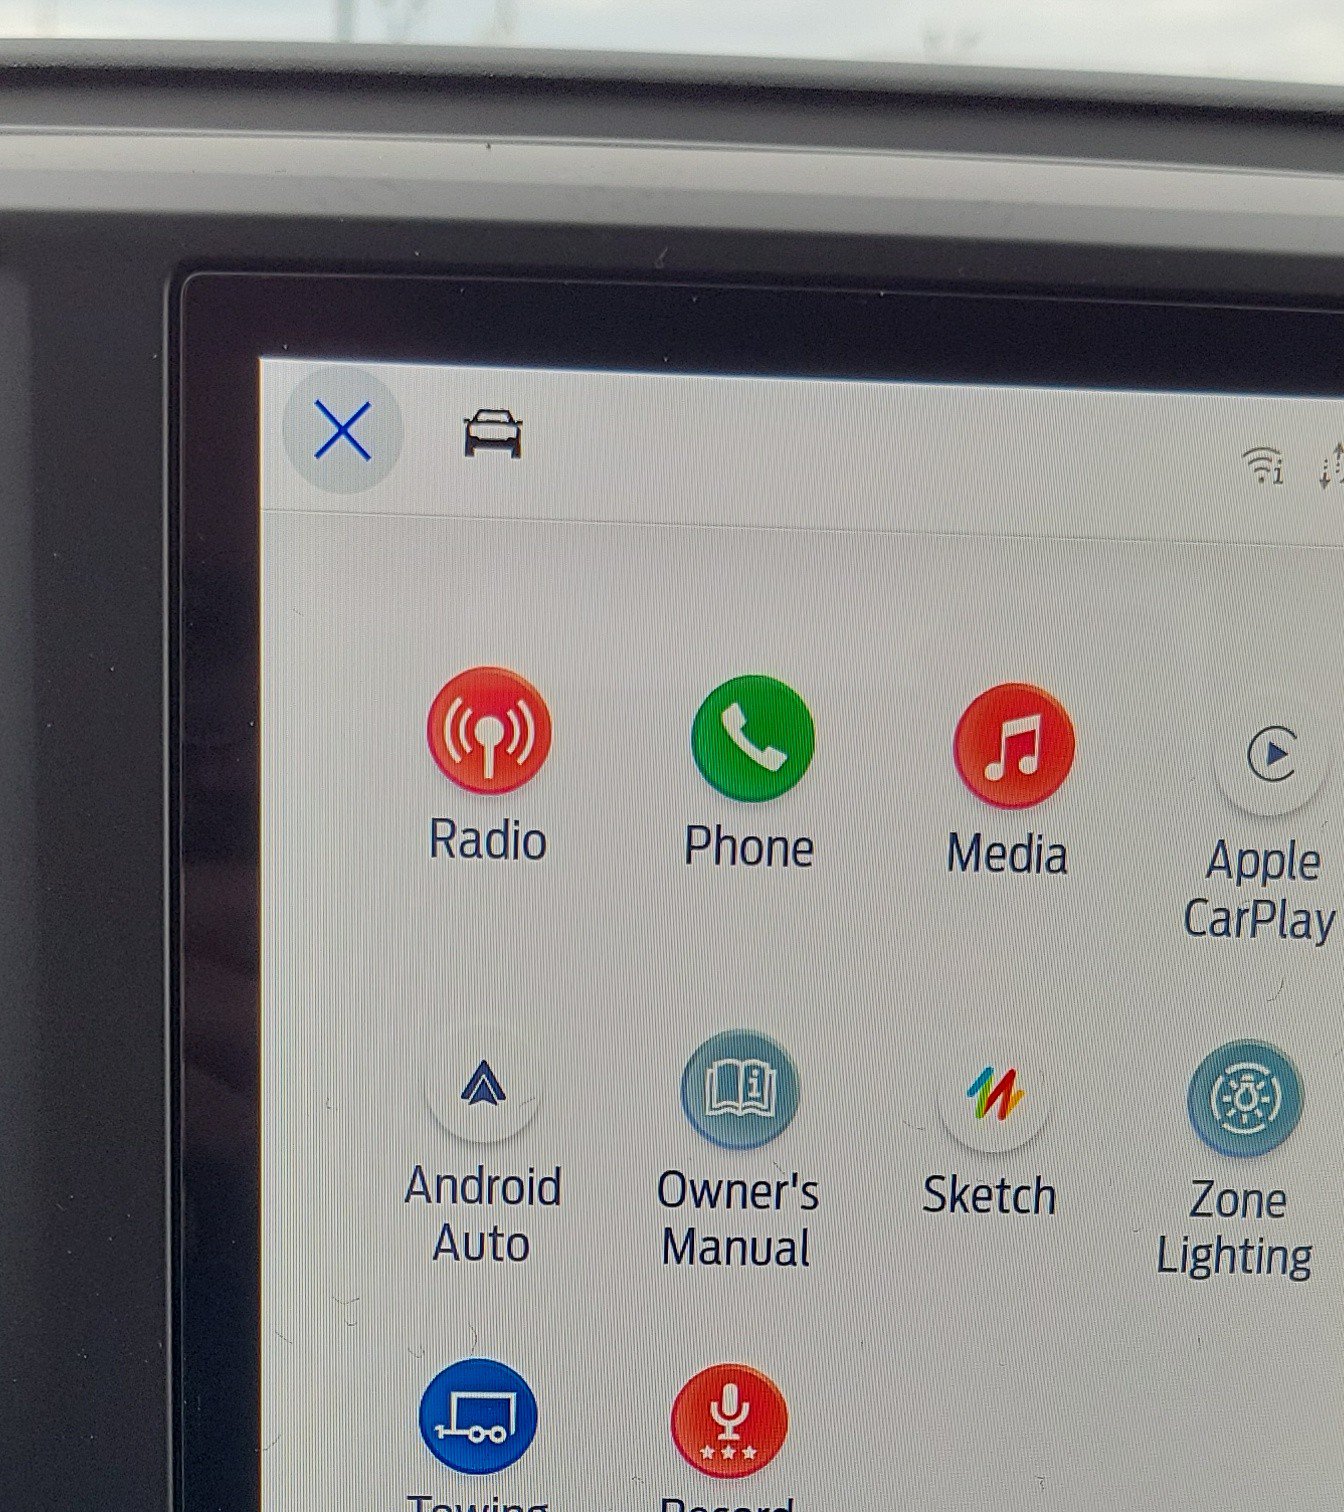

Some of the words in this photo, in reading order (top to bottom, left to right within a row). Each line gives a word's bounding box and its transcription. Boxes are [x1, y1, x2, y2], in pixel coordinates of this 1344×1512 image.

[430, 817, 547, 861] Radio
[685, 823, 814, 868] Phone
[948, 831, 1068, 875] Media
[1205, 838, 1321, 888] Apple
[1184, 897, 1337, 948] CarPlay
[403, 1164, 562, 1206] Android
[657, 1169, 820, 1211] Owner's
[922, 1173, 1056, 1215] Sketch
[1189, 1179, 1287, 1219] Zone
[432, 1222, 530, 1262] Auto
[663, 1226, 810, 1267] Manual
[1157, 1234, 1314, 1283] Lighting
